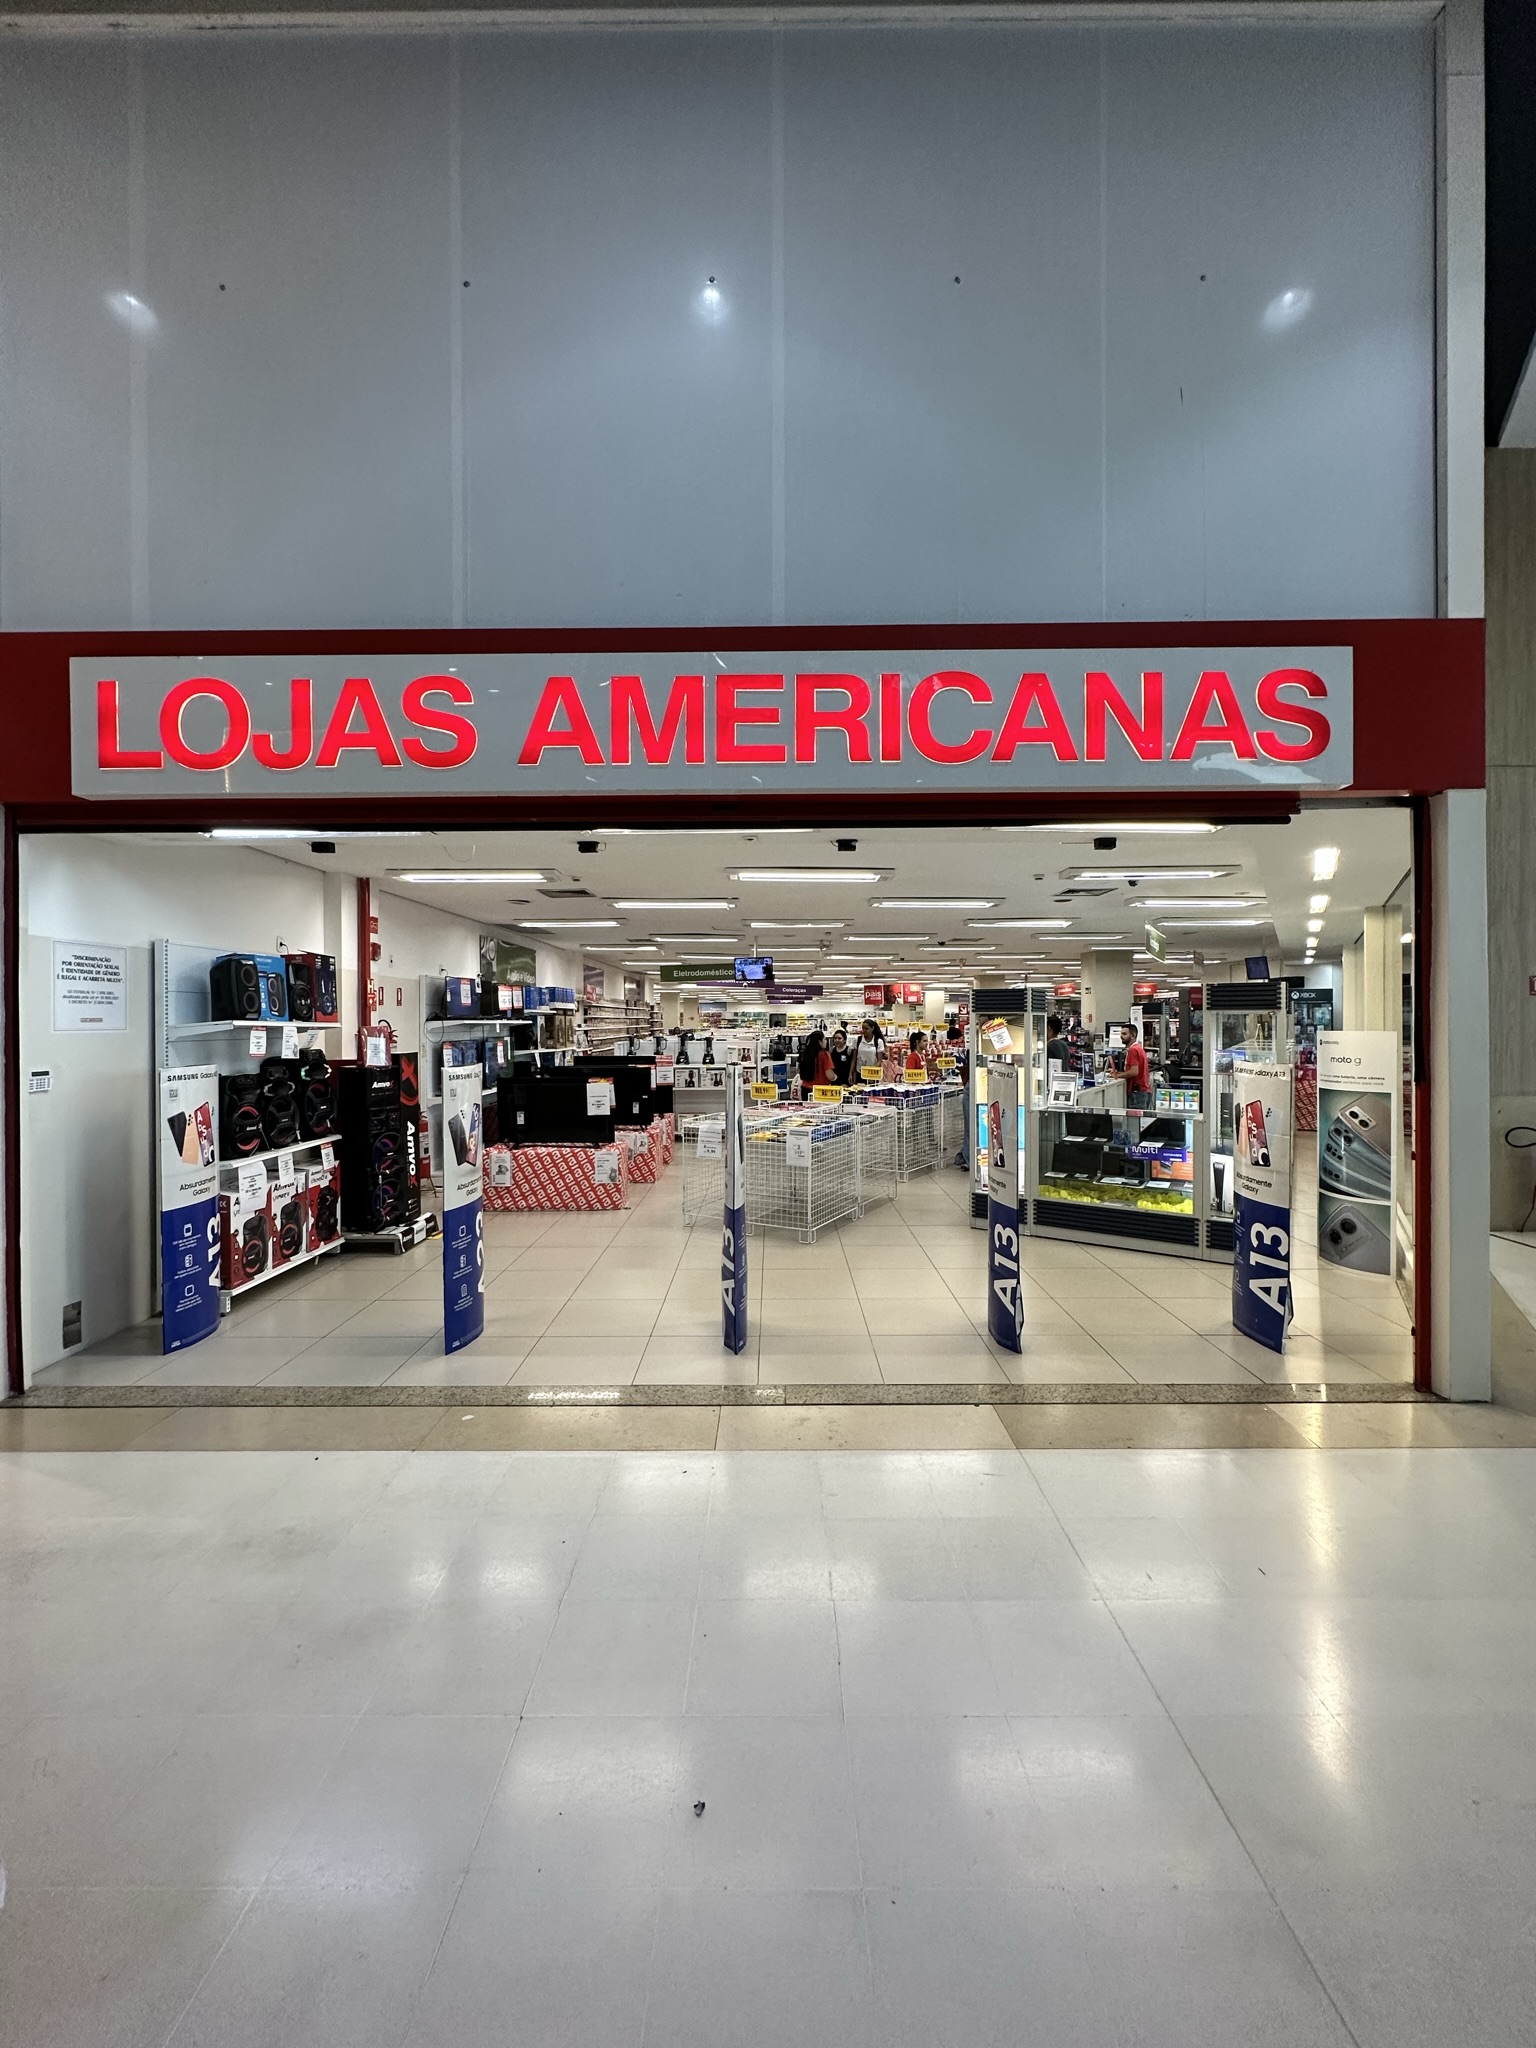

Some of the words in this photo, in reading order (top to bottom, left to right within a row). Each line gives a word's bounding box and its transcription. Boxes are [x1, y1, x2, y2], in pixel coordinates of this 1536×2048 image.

[97, 674, 478, 771] LOJAS
[517, 668, 1332, 766] AMERICANAS
[73, 961, 103, 969] ORIENTAÇÃO
[102, 969, 120, 977] GÊNERO
[1330, 1056, 1352, 1064] moto
[1353, 1057, 1362, 1067] g
[167, 1073, 199, 1082] SAMSUNG
[448, 1073, 473, 1081] SAMSUNG
[407, 1120, 418, 1187] Amvox
[993, 1223, 1018, 1317] A13
[1249, 1222, 1289, 1316] A13
